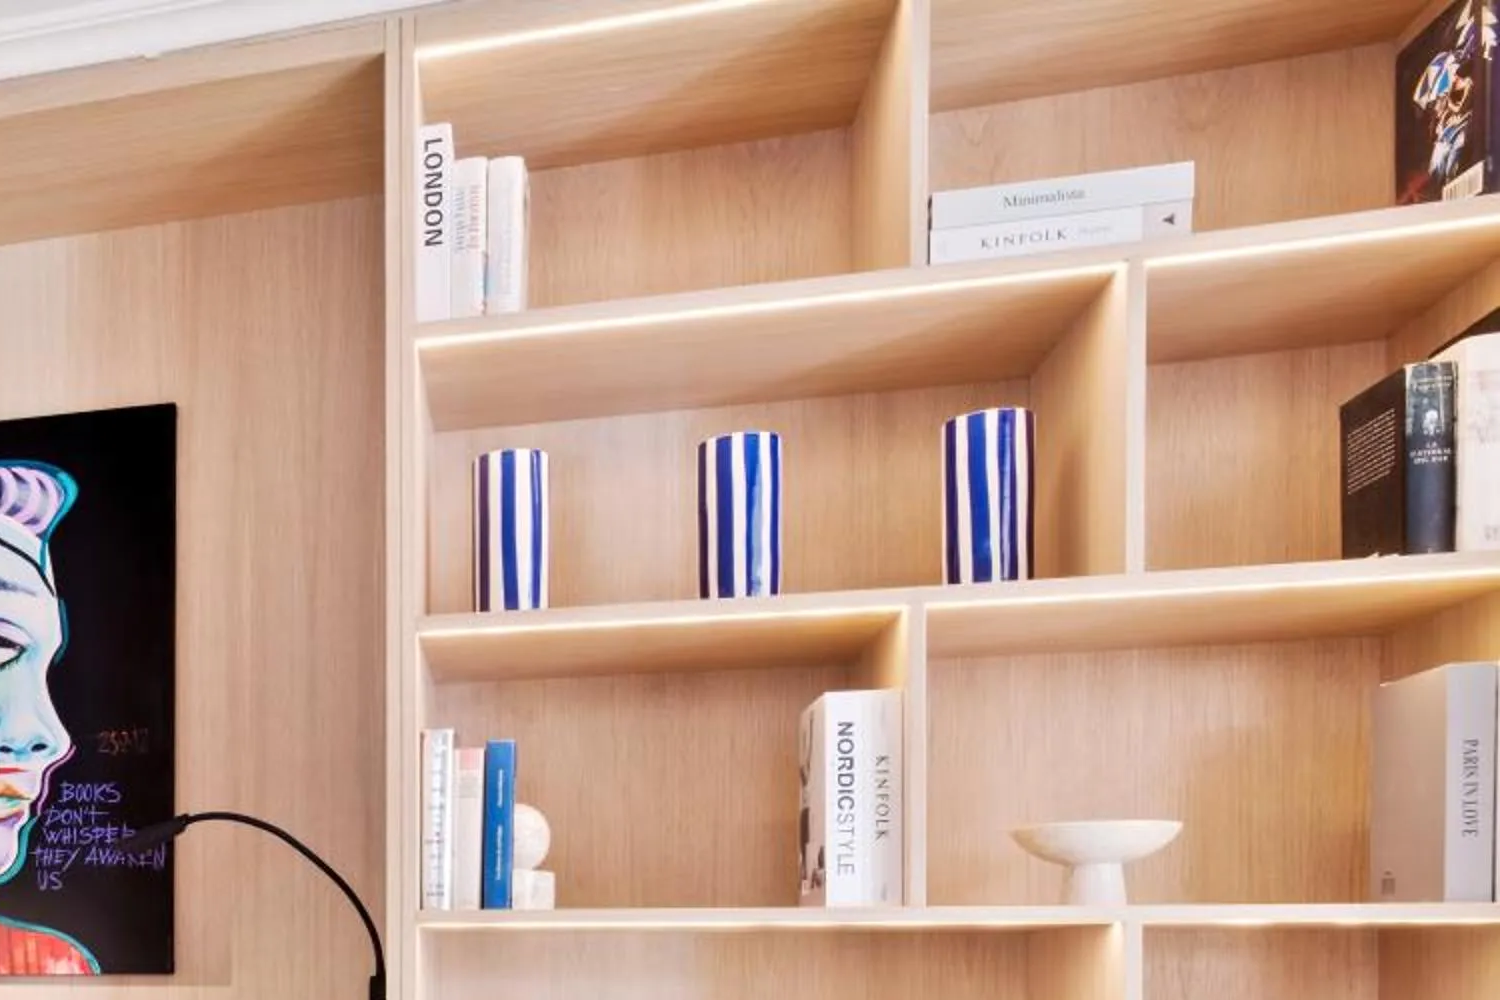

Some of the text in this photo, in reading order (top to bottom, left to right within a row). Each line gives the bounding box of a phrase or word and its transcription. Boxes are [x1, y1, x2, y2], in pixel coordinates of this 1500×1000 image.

[423, 137, 444, 247] LONDON
[980, 228, 1069, 250] KINFOLK
[1462, 738, 1480, 779] PARIS
[58, 779, 122, 803] BOOKS
[874, 754, 892, 842] KINFOLK
[1462, 799, 1479, 838] LOVE
[28, 845, 81, 873] THEY
[36, 870, 64, 892] US
